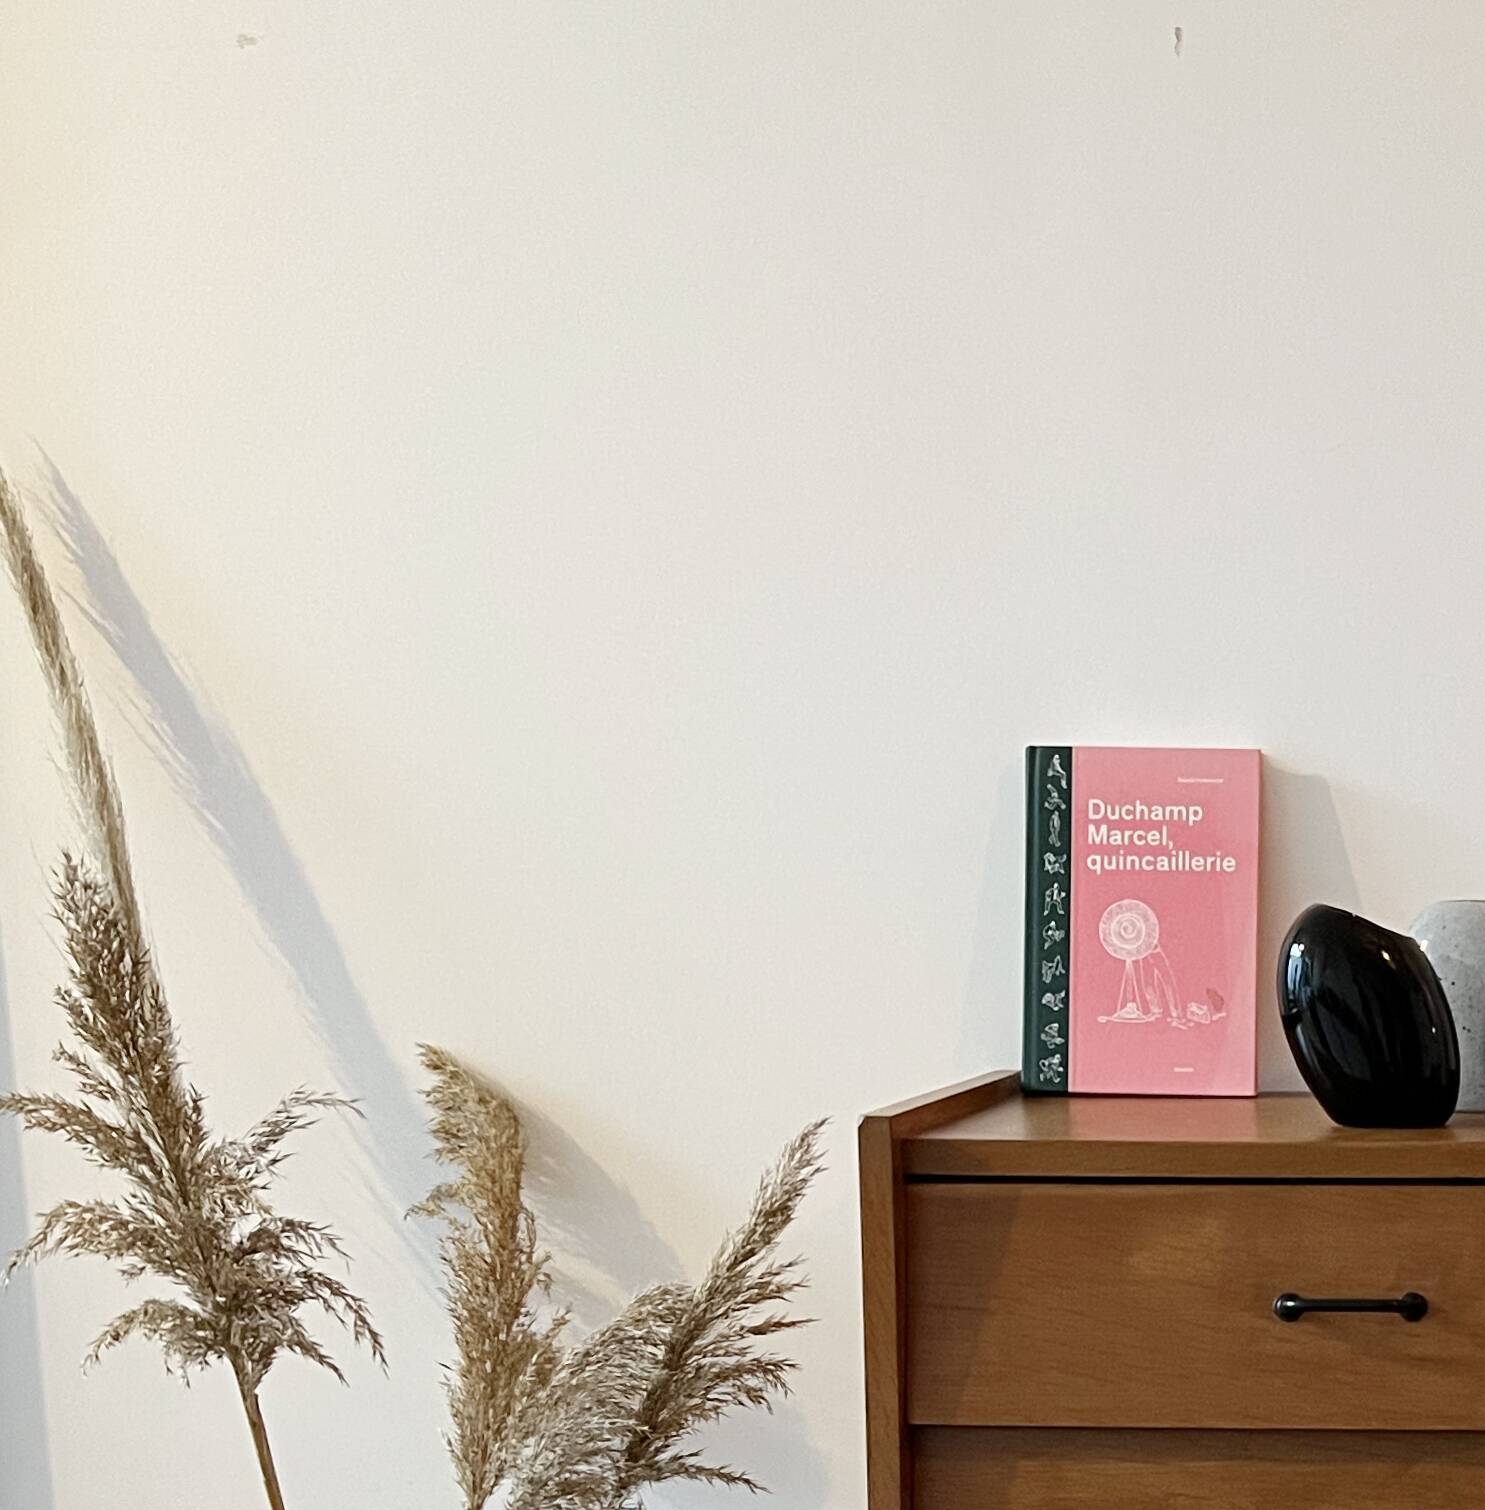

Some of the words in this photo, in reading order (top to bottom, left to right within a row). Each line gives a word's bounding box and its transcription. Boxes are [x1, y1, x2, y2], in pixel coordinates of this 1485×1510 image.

[1087, 798, 1203, 827] Duchamp
[1087, 823, 1174, 850] Marcel,
[1086, 850, 1237, 875] quincaillerie
